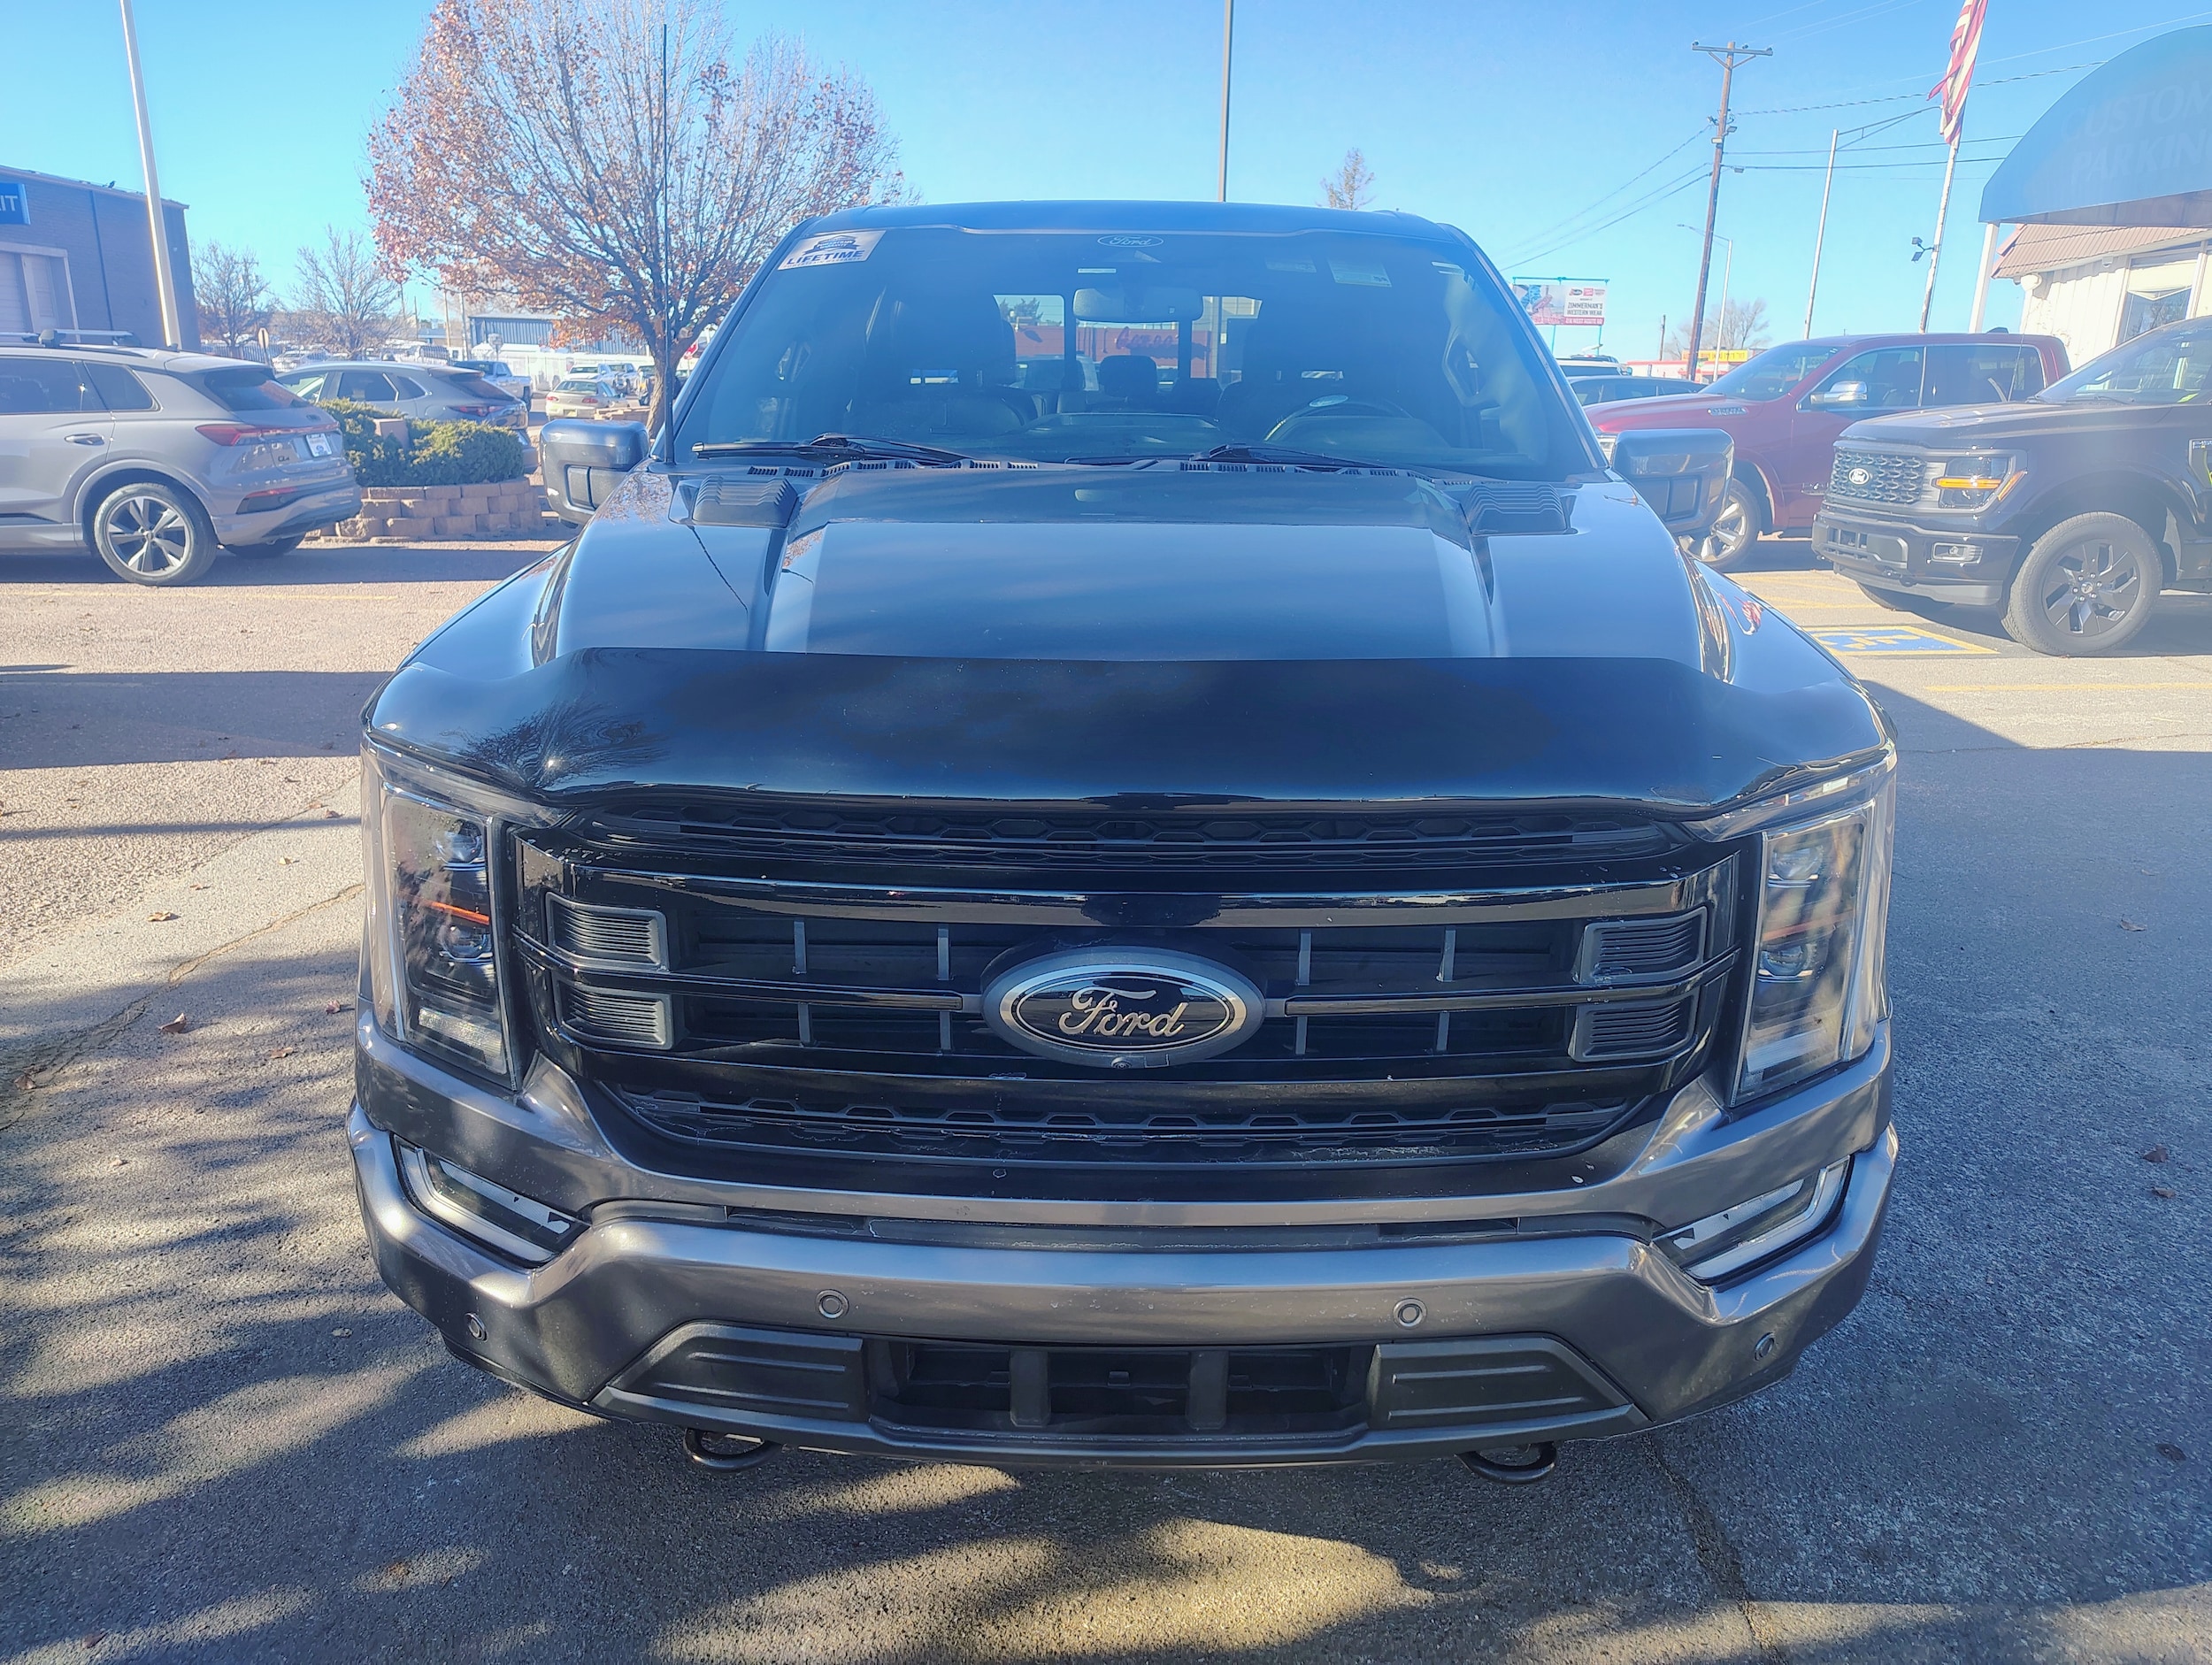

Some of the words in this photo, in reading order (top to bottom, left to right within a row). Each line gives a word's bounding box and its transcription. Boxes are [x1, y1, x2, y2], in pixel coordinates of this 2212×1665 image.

[2070, 127, 2212, 184] PARKIN
[0, 195, 19, 211] IT
[1110, 235, 1152, 245] Ford
[787, 249, 865, 265] LIFETIME
[1058, 986, 1189, 1037] Ford
